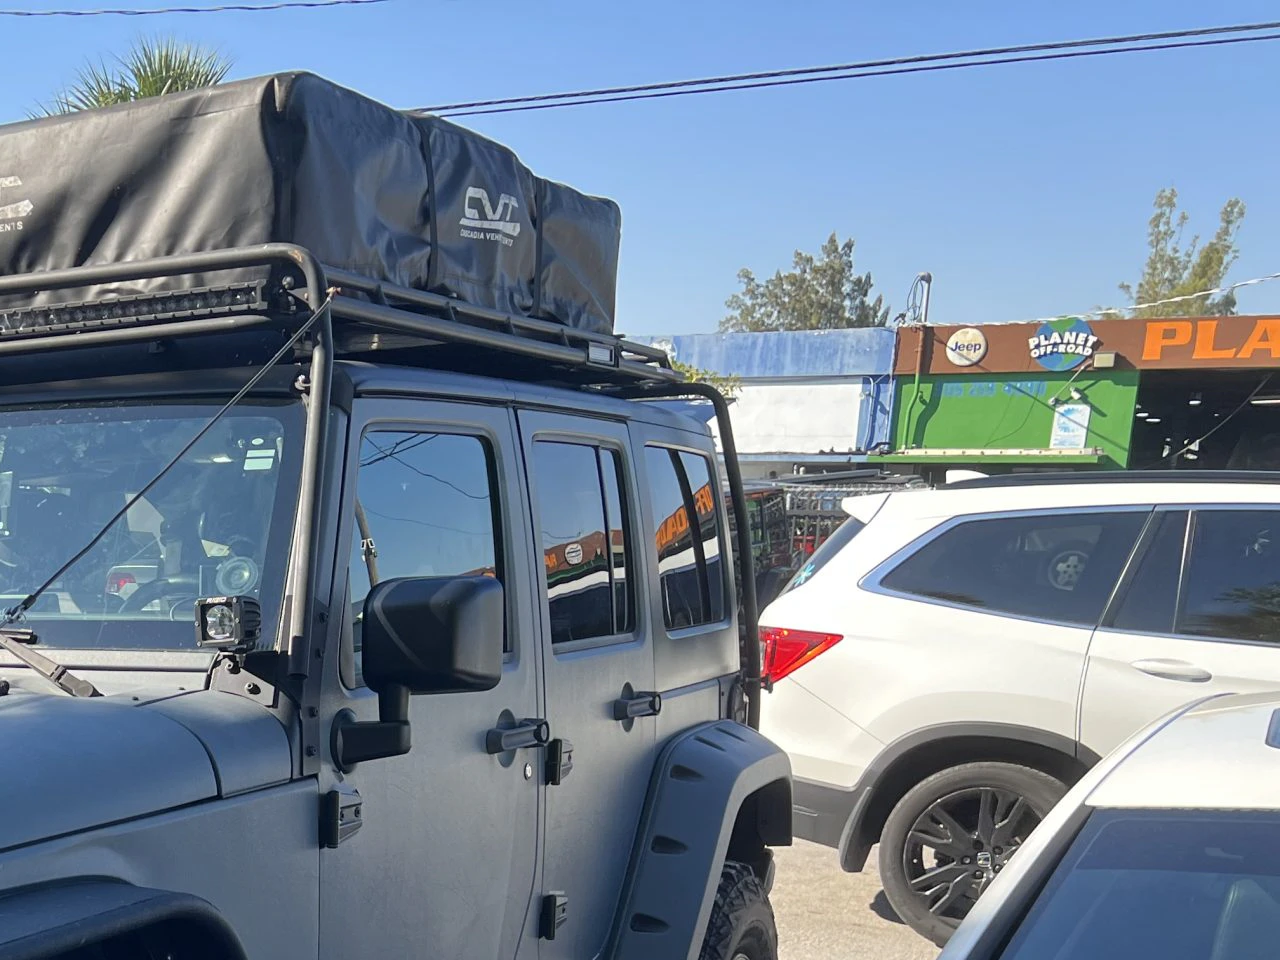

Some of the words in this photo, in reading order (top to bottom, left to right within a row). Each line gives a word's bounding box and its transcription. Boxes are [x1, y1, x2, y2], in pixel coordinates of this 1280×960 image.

[464, 186, 519, 222] CVT
[951, 341, 982, 353] Jeep
[1028, 331, 1099, 349] PLANET
[1142, 319, 1280, 360] PLA
[1030, 343, 1093, 358] OFF-ROAD
